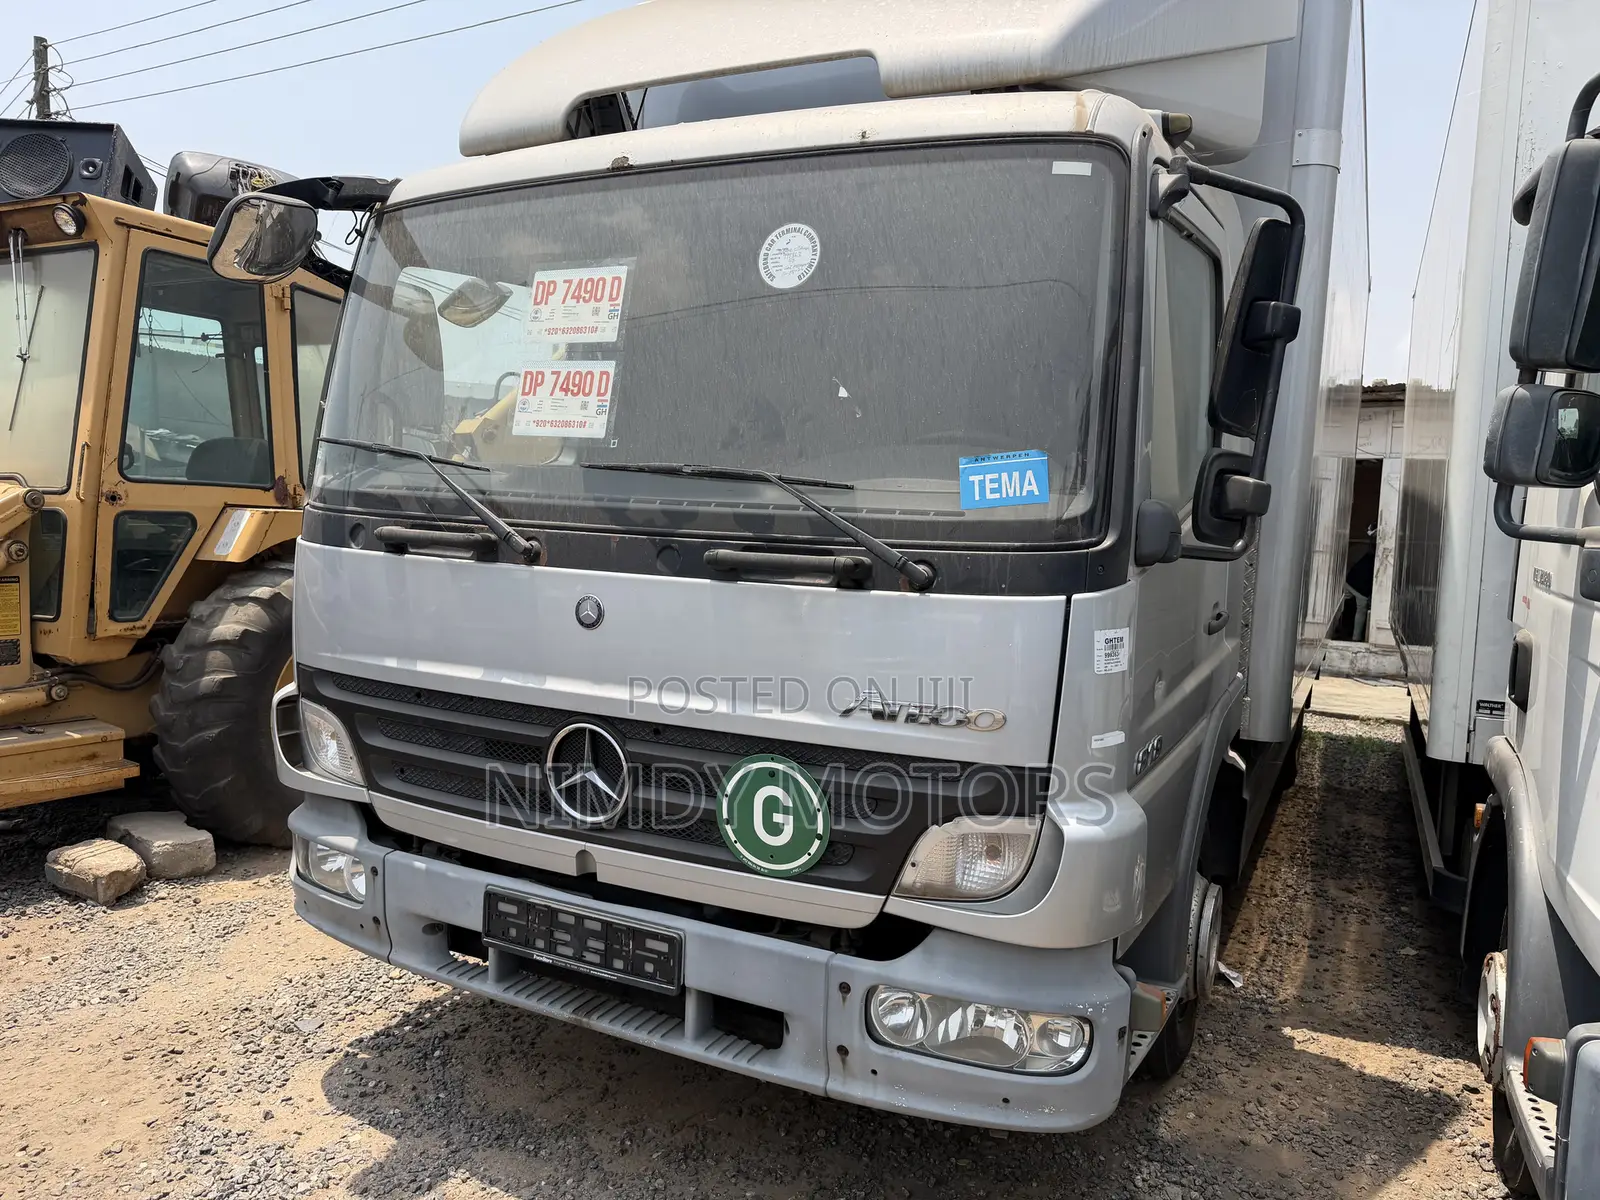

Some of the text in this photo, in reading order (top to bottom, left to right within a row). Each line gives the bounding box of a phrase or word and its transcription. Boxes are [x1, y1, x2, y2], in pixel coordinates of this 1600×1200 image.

[774, 226, 804, 240] TERMINAL
[803, 229, 818, 257] COMPANY
[765, 238, 777, 252] CAR
[797, 258, 817, 281] LIMITED
[533, 275, 623, 306] DP 7490 D
[607, 312, 619, 320] GH
[521, 370, 610, 397] DP 7490 D
[595, 408, 607, 416] GH
[974, 452, 1030, 463] ANTWERPEN
[968, 469, 1040, 501] TEMA
[753, 785, 794, 847] G
